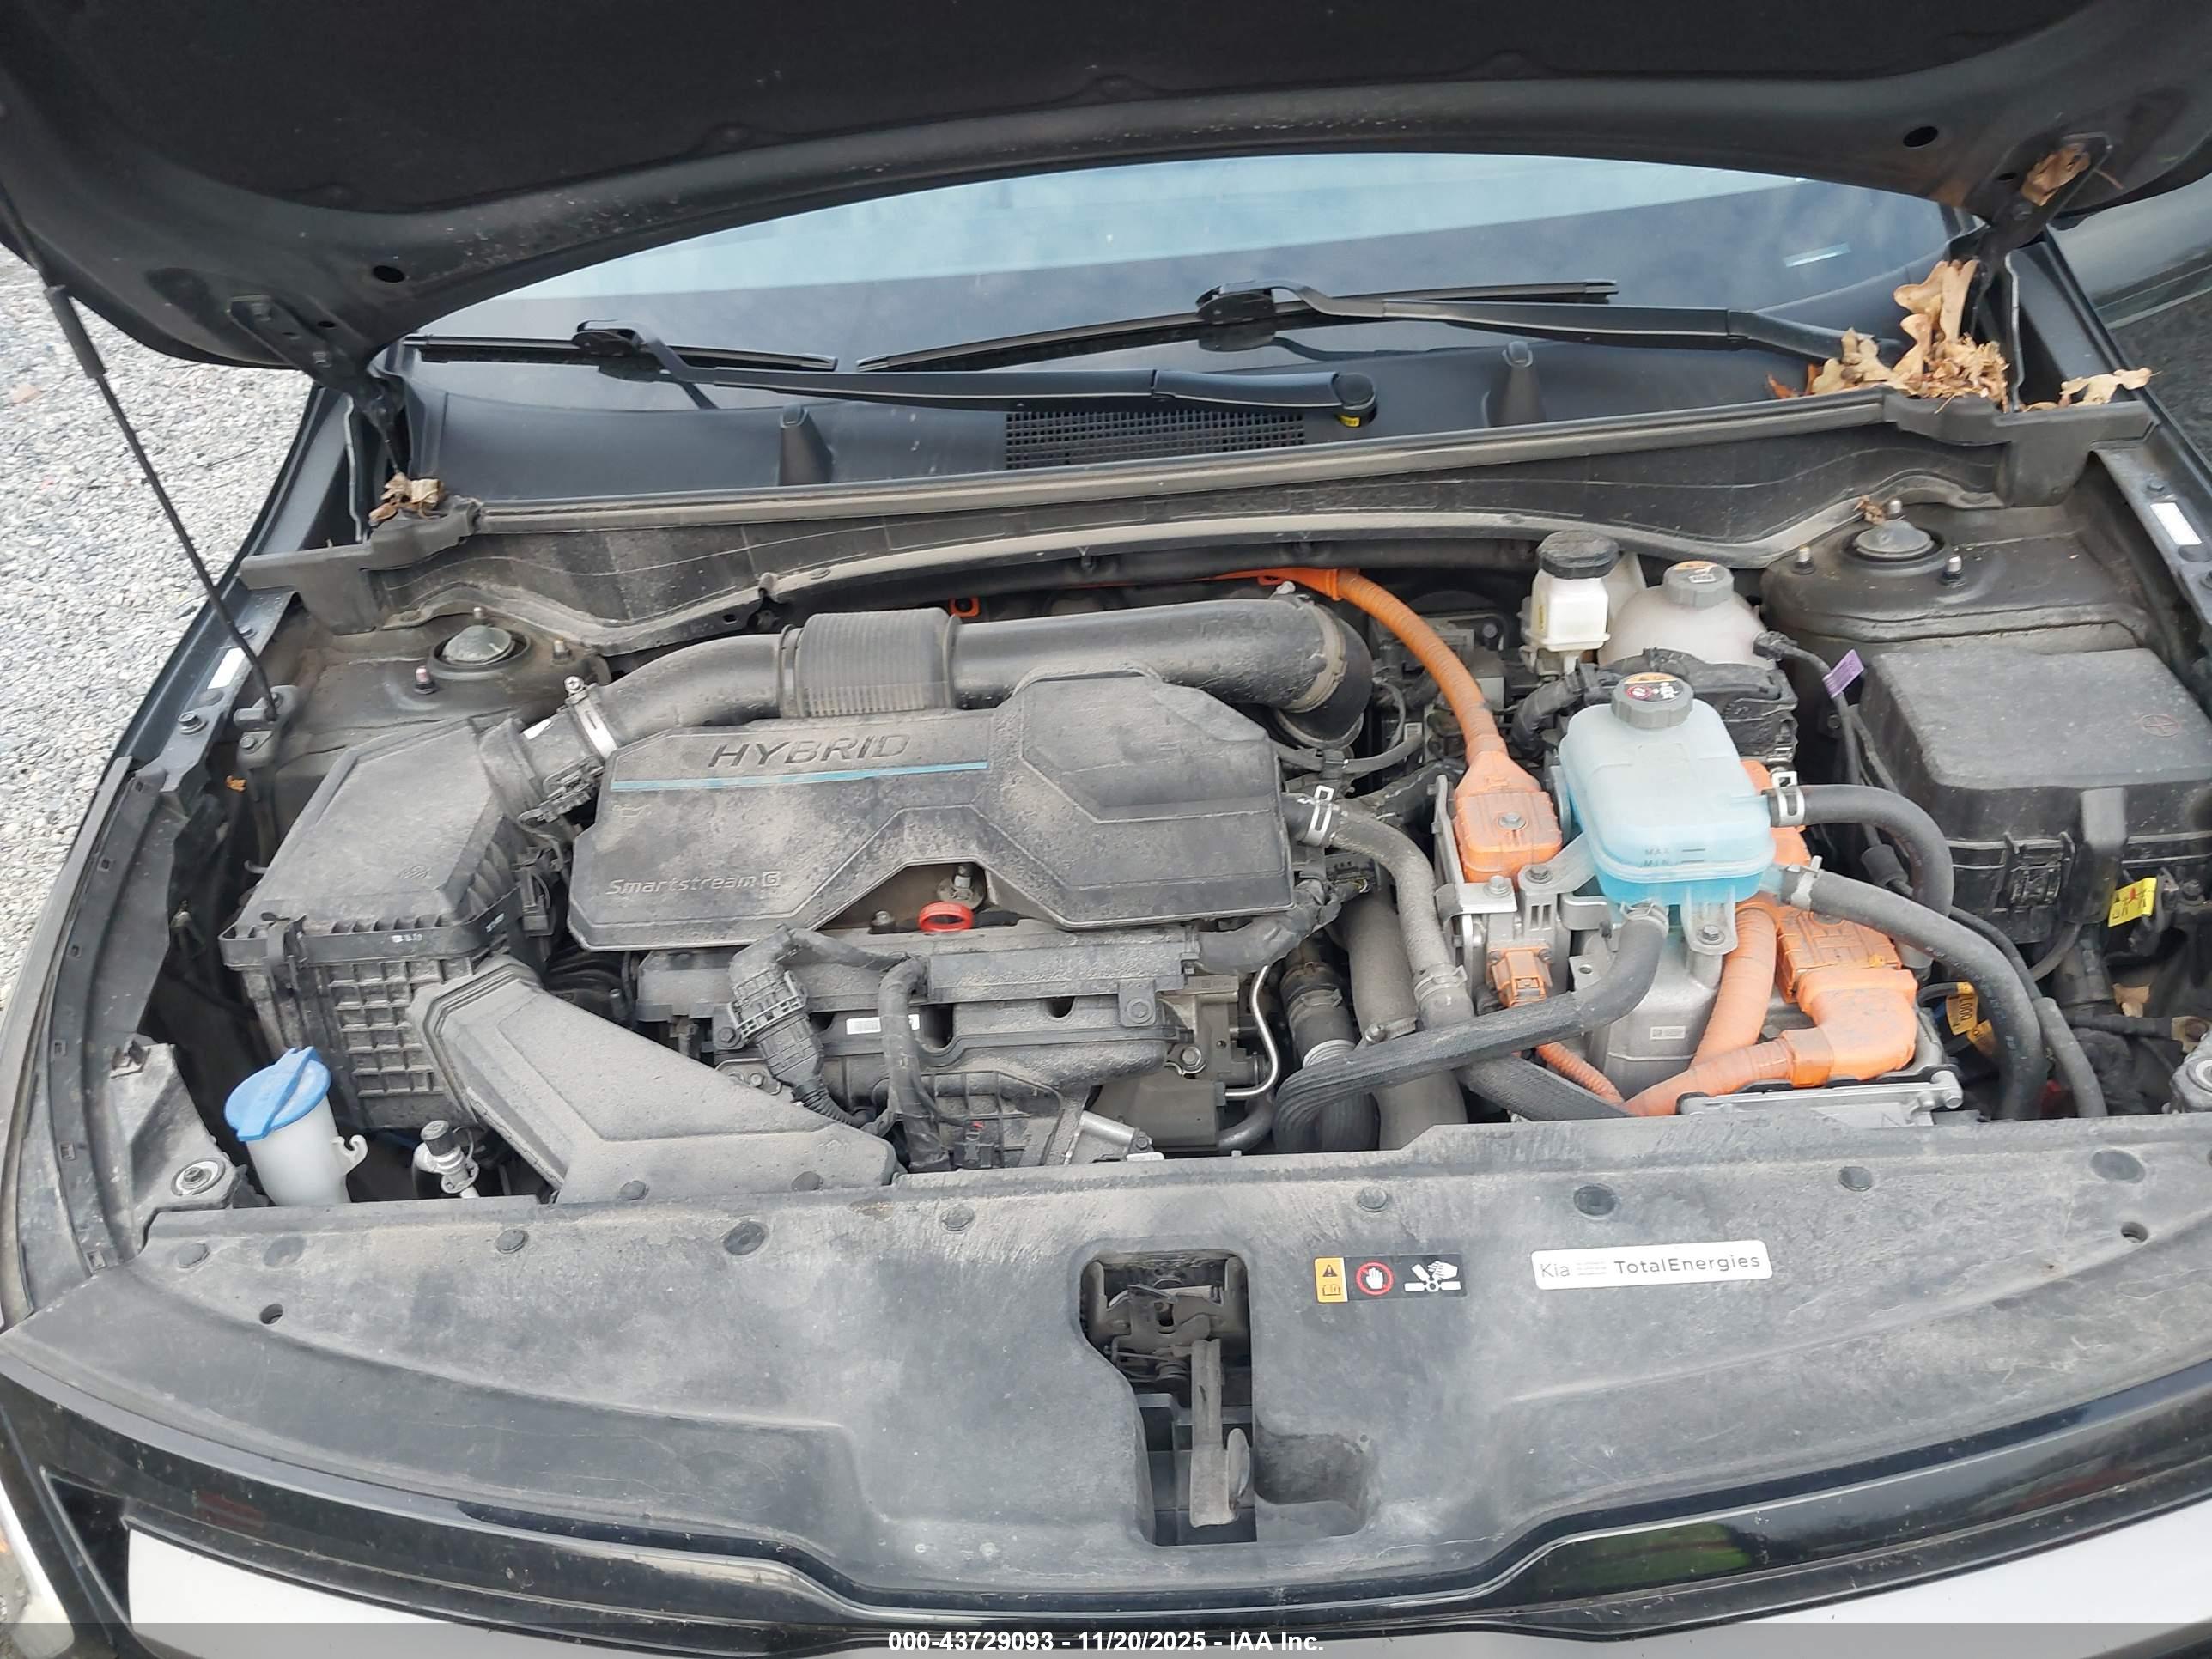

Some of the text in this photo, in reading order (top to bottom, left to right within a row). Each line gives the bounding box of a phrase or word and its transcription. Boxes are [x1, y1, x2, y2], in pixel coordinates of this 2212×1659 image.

[708, 734, 908, 768] HYBRID
[605, 875, 757, 895] Smartstream
[1540, 1263, 1571, 1278] Kia
[1613, 1254, 1760, 1274] TotalEnergies
